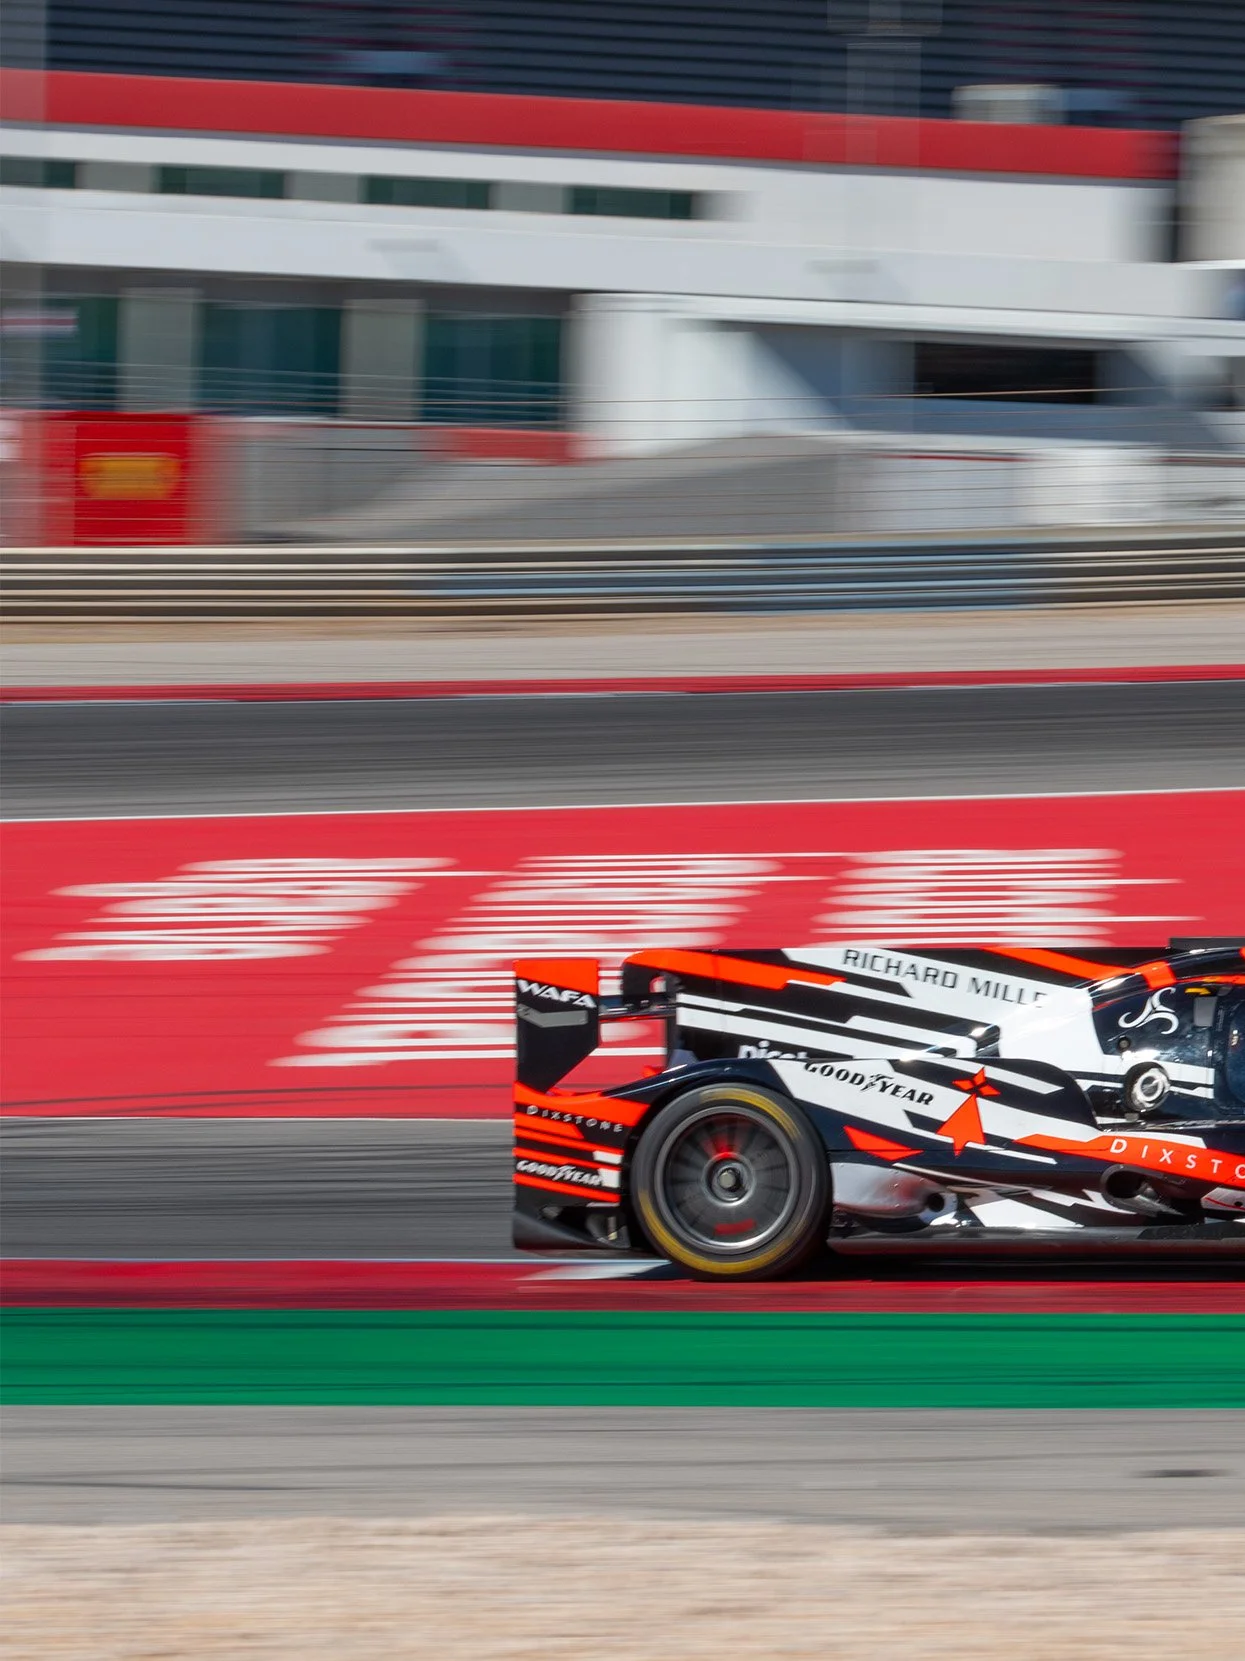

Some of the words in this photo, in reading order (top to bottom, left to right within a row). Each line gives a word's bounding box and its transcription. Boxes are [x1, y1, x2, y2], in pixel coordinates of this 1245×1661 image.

[843, 949, 959, 989] RICHARD
[517, 979, 597, 1008] WAFA
[804, 1062, 935, 1106] GOODYEAR
[526, 1105, 623, 1133] DIXSTONE
[515, 1160, 603, 1186] GOODYEAR
